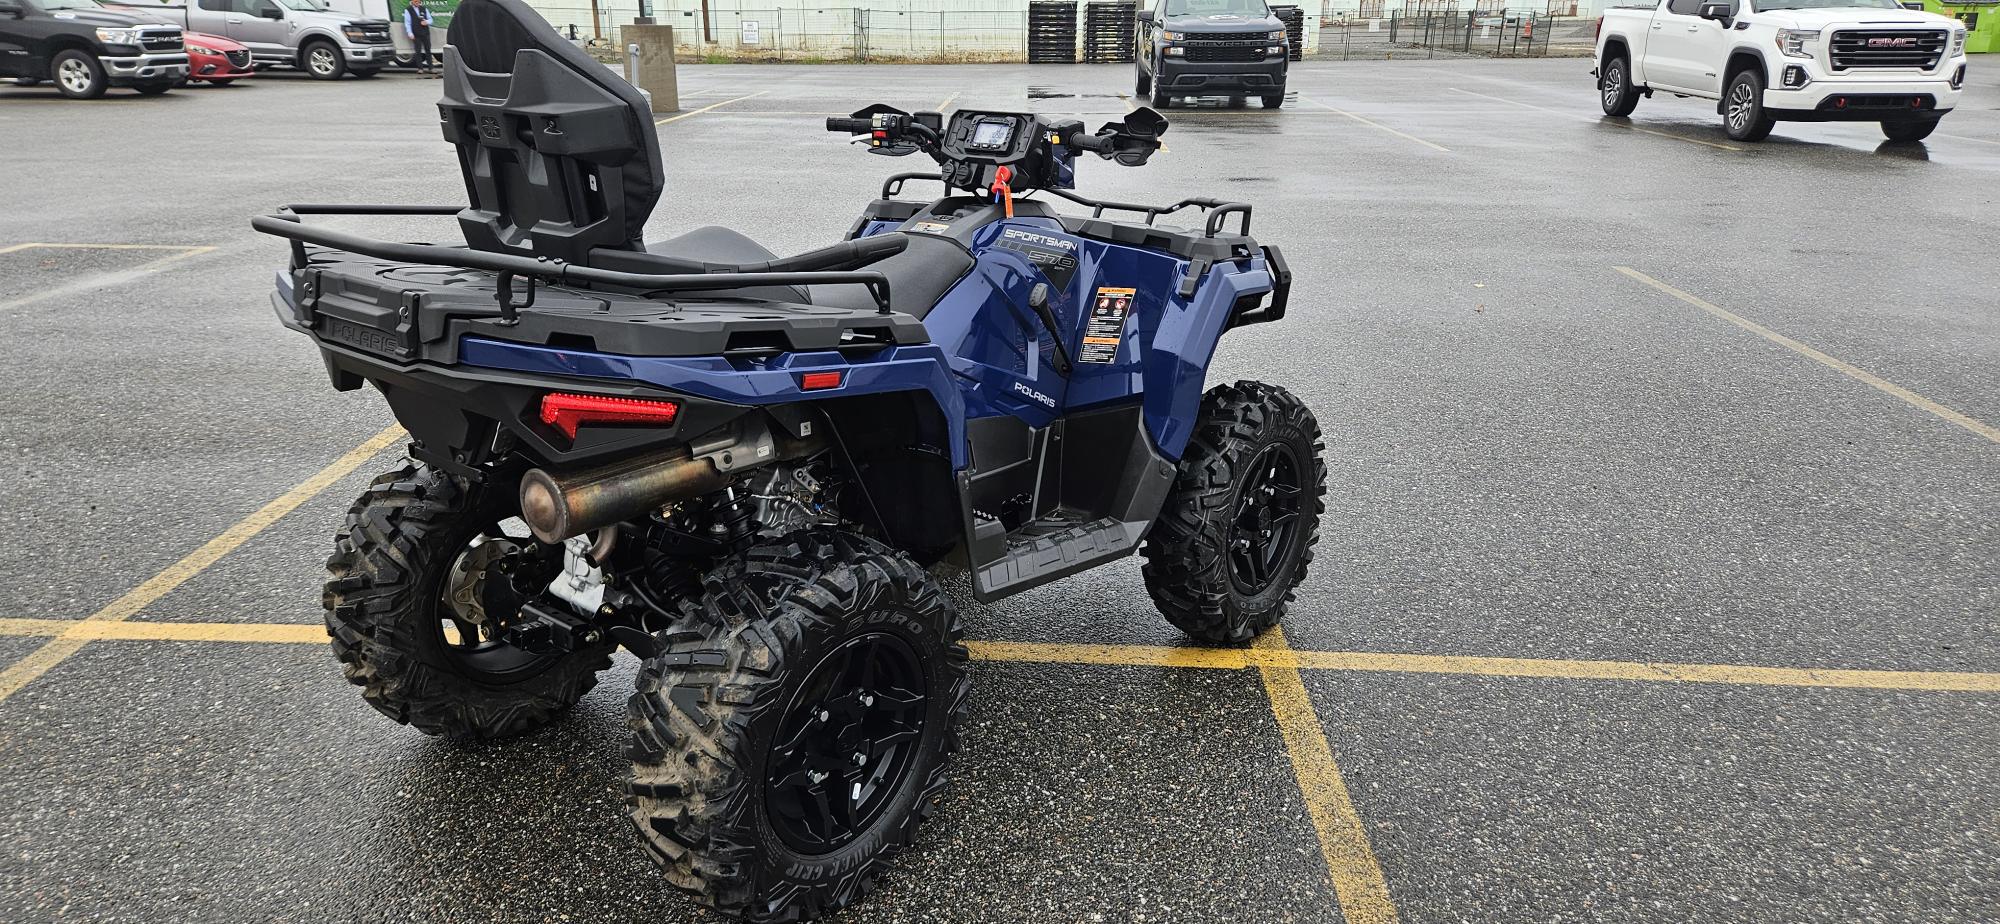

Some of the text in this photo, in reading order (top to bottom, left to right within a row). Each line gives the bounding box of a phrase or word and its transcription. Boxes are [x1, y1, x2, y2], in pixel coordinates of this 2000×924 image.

[1868, 37, 1917, 48] GMC
[1004, 228, 1078, 251] SPORTSMAN
[1027, 250, 1076, 269] 570
[330, 319, 398, 354] POLARIS
[1014, 381, 1056, 408] POLARIS
[844, 608, 923, 635] DURO
[785, 863, 824, 880] GRIP
